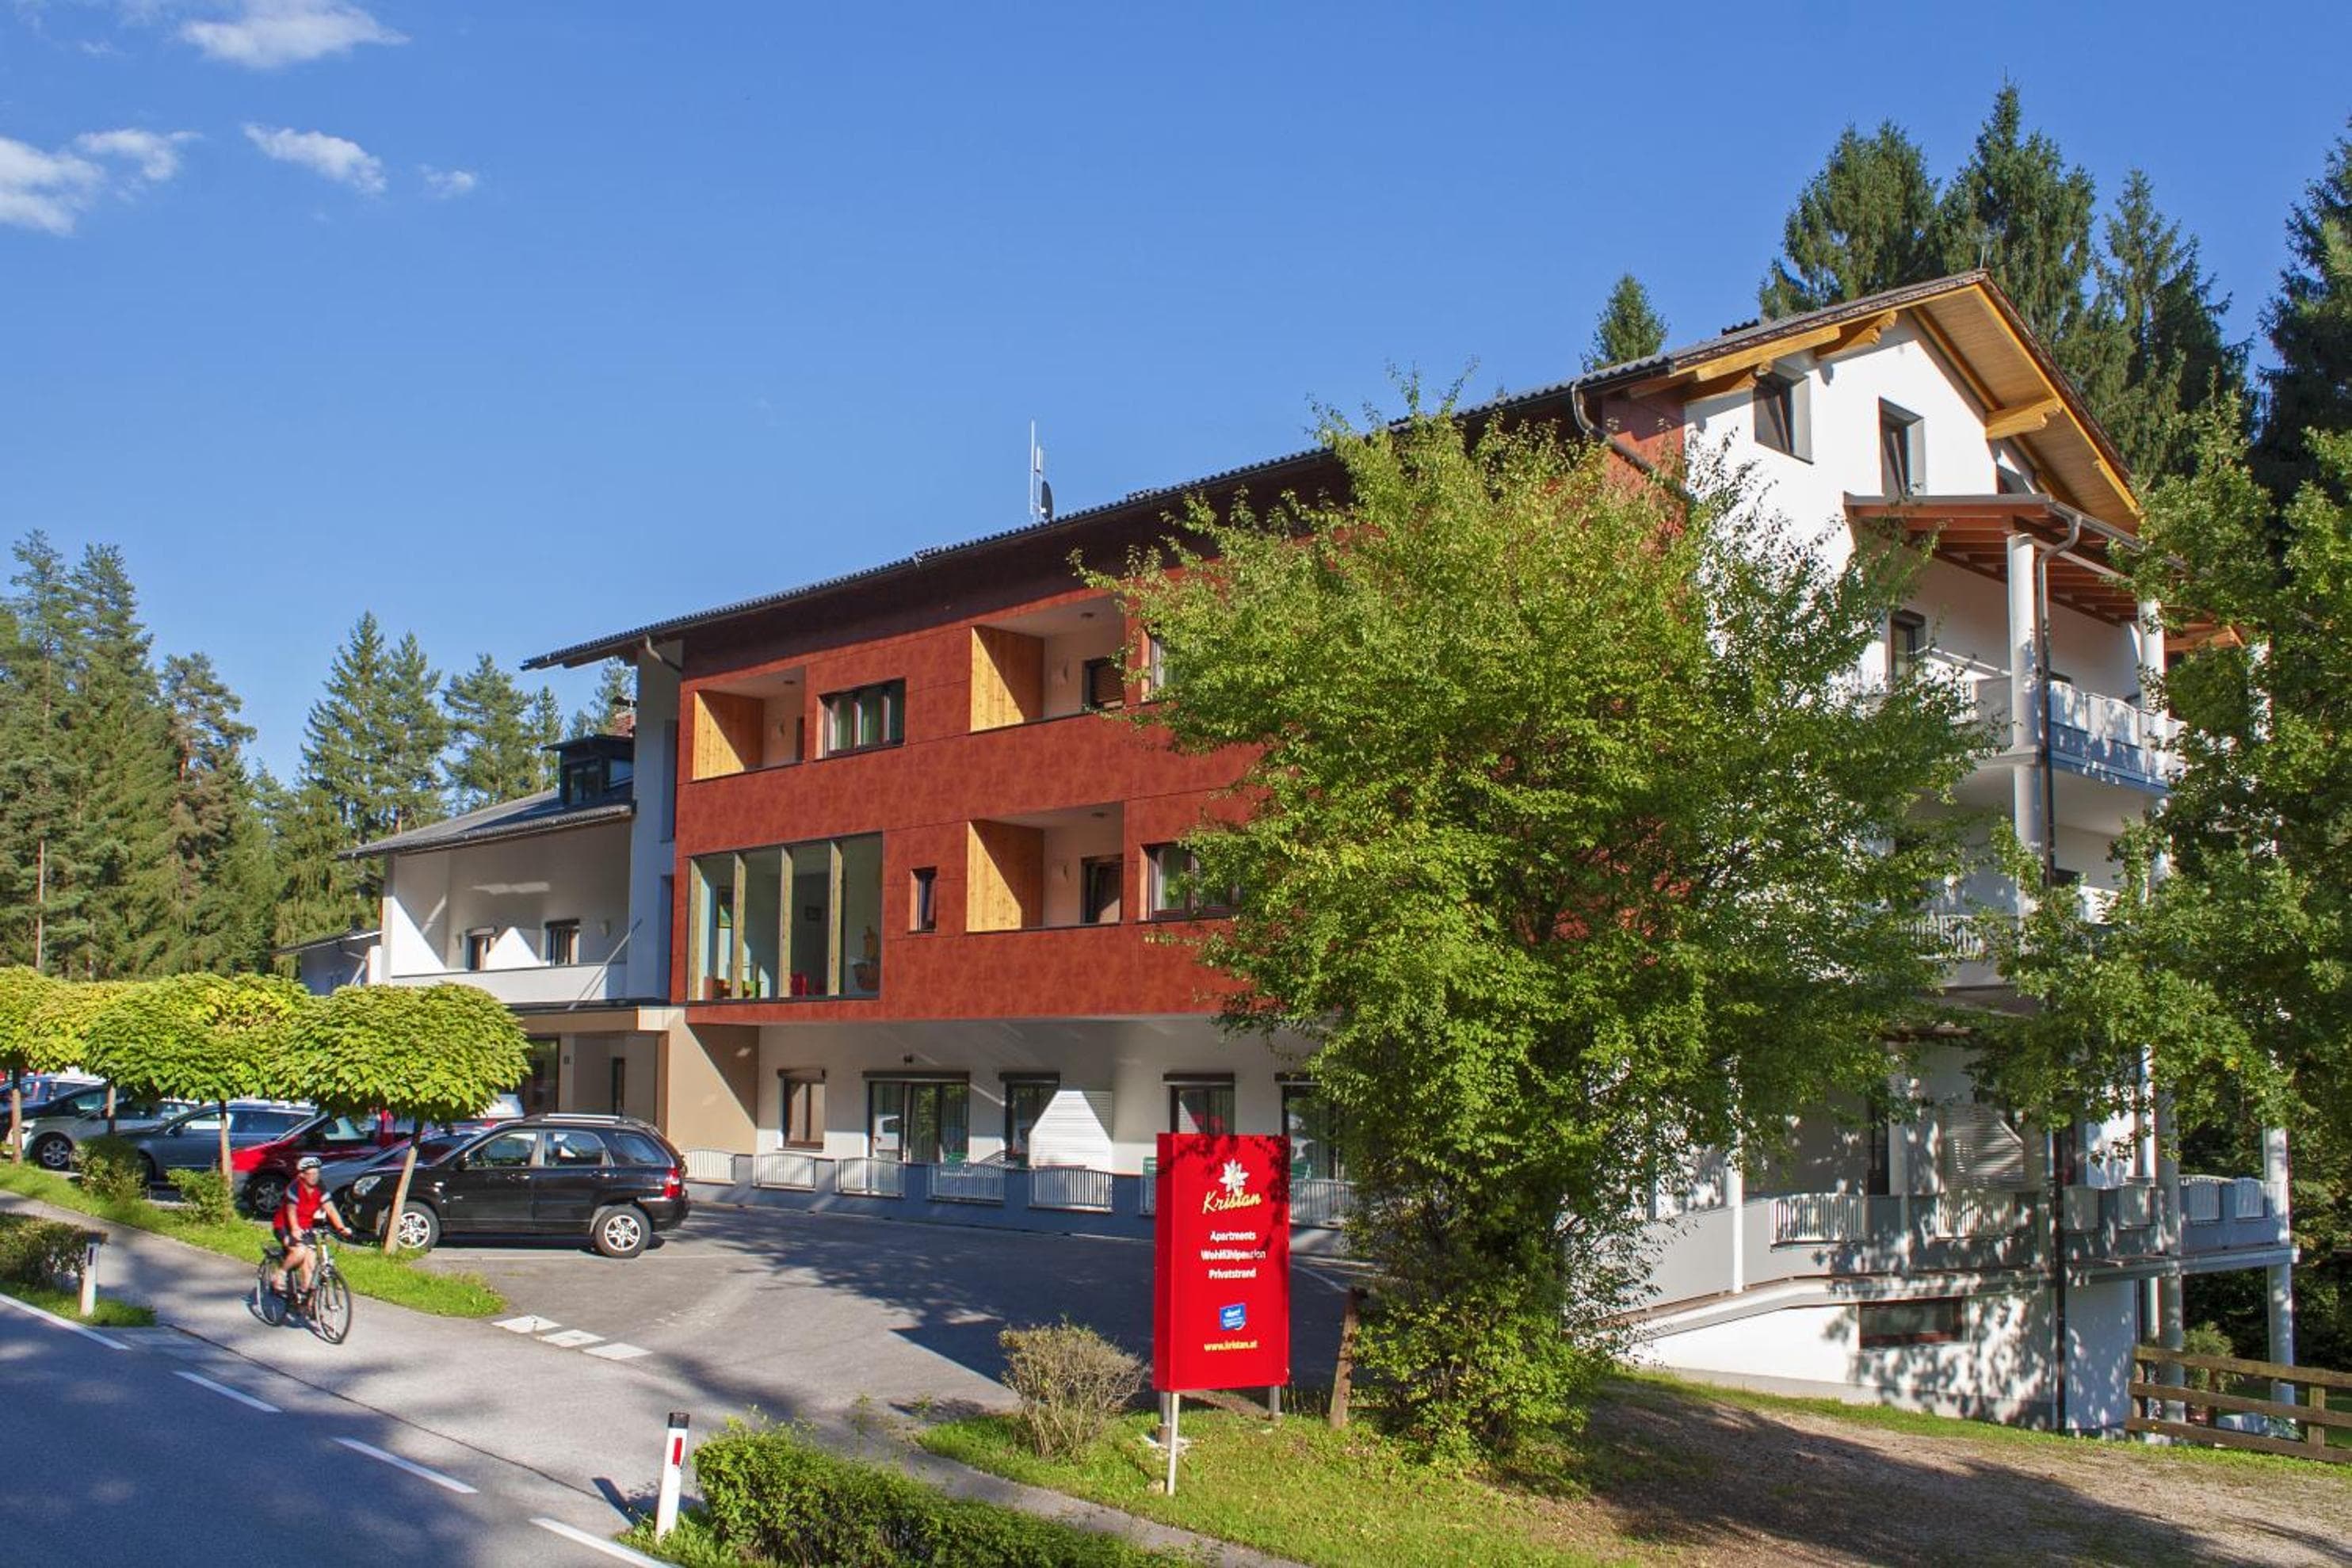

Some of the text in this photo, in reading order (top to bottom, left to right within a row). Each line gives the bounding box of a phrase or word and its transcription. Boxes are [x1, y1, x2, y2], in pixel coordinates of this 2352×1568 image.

[1202, 1188, 1262, 1214] Kristan
[1209, 1230, 1256, 1242] Apartments
[1208, 1268, 1256, 1279] Privatstrand
